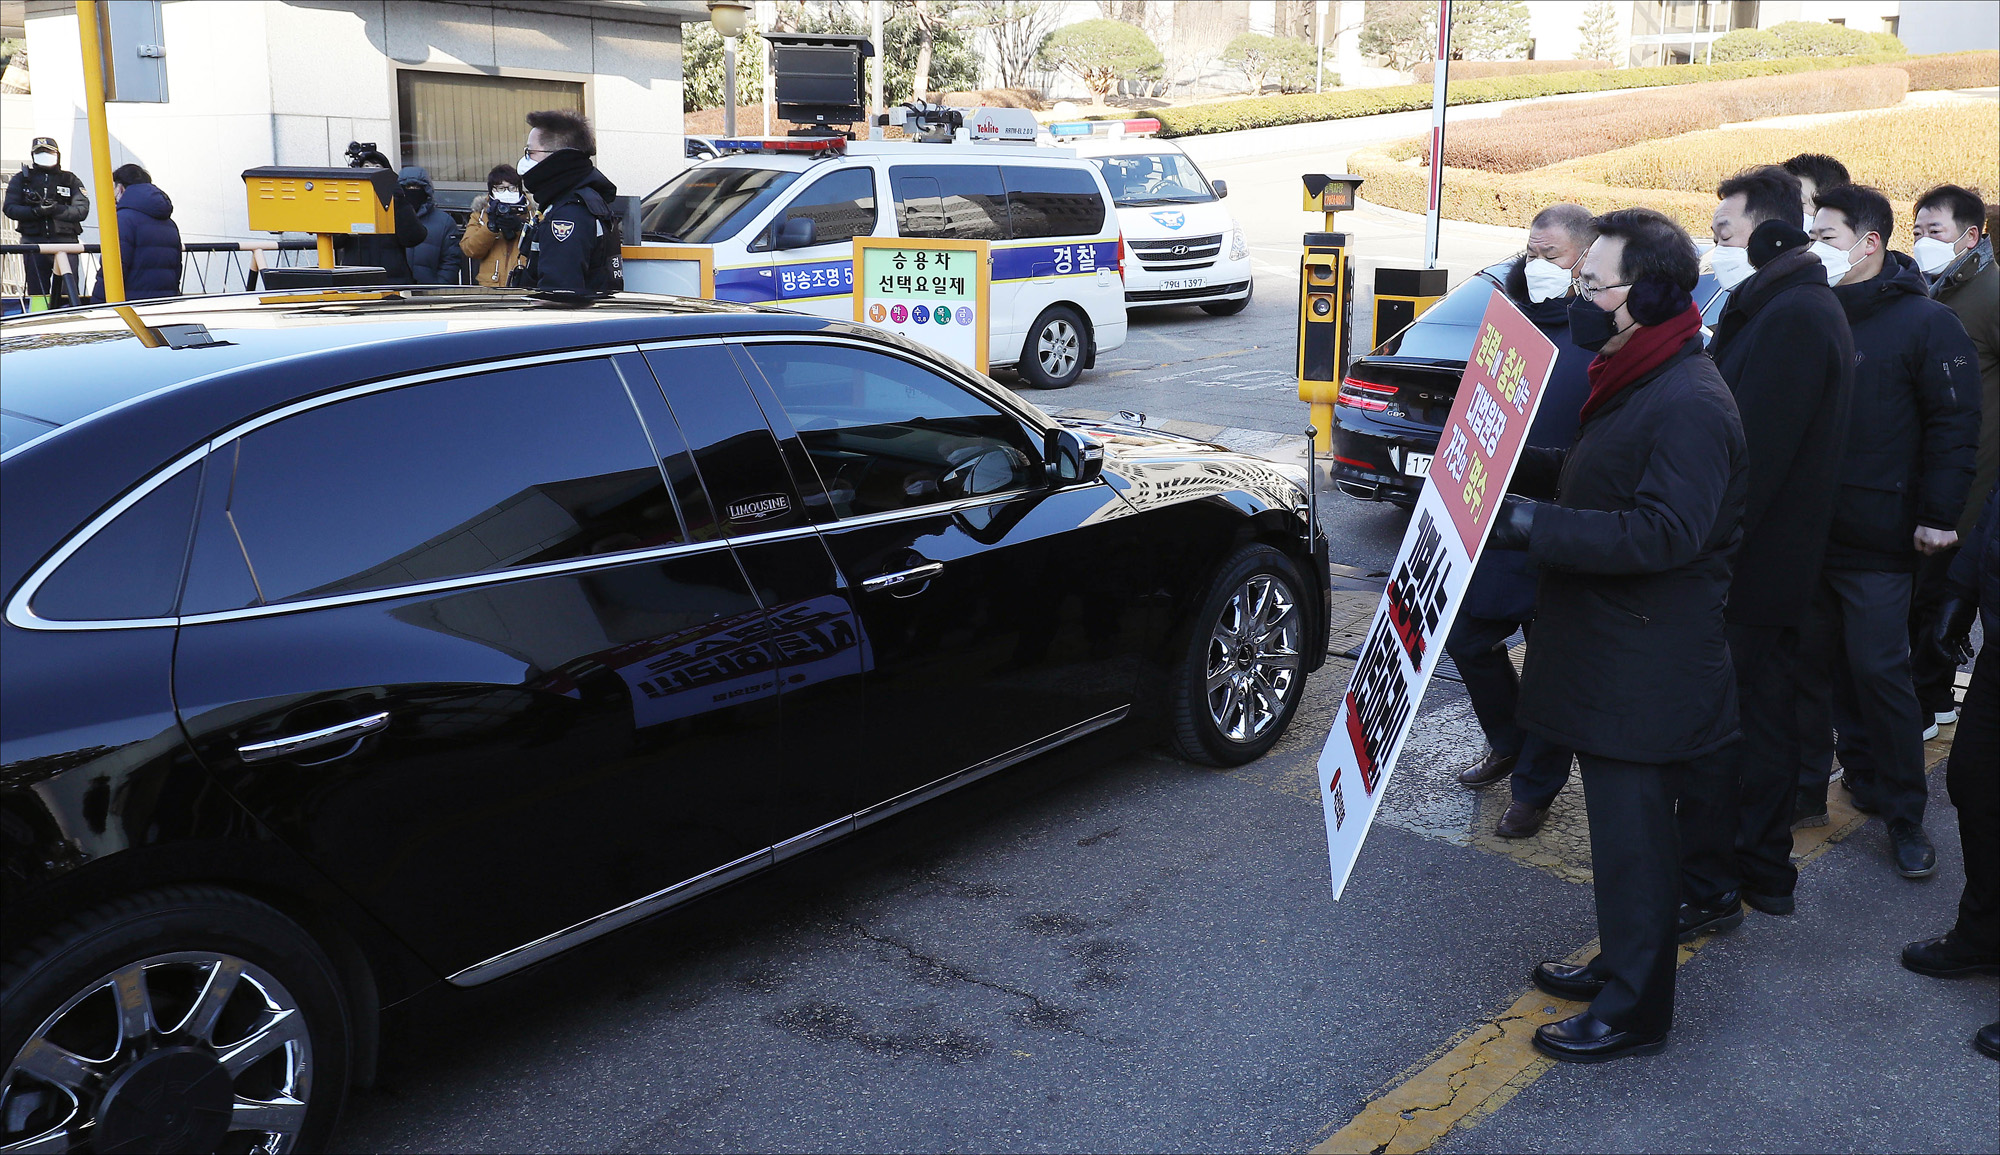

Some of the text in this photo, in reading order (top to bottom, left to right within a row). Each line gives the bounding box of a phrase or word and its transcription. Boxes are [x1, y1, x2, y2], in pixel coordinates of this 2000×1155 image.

[977, 121, 999, 134] Teklite
[892, 251, 952, 271] 승용차
[1053, 244, 1098, 274] 경찰
[781, 267, 841, 291] 방송조명
[878, 274, 966, 296] 선택요일제
[1183, 278, 1203, 288] 1397
[893, 306, 901, 315] 화
[1475, 322, 1531, 416] 권력에 충성하는
[1387, 410, 1406, 418] G80
[1465, 381, 1508, 459] 대법원장
[1442, 422, 1469, 484] 거짓의
[1413, 457, 1432, 474] 17
[729, 496, 787, 517] LIMOUSINE
[1391, 507, 1452, 674] 김명수는
